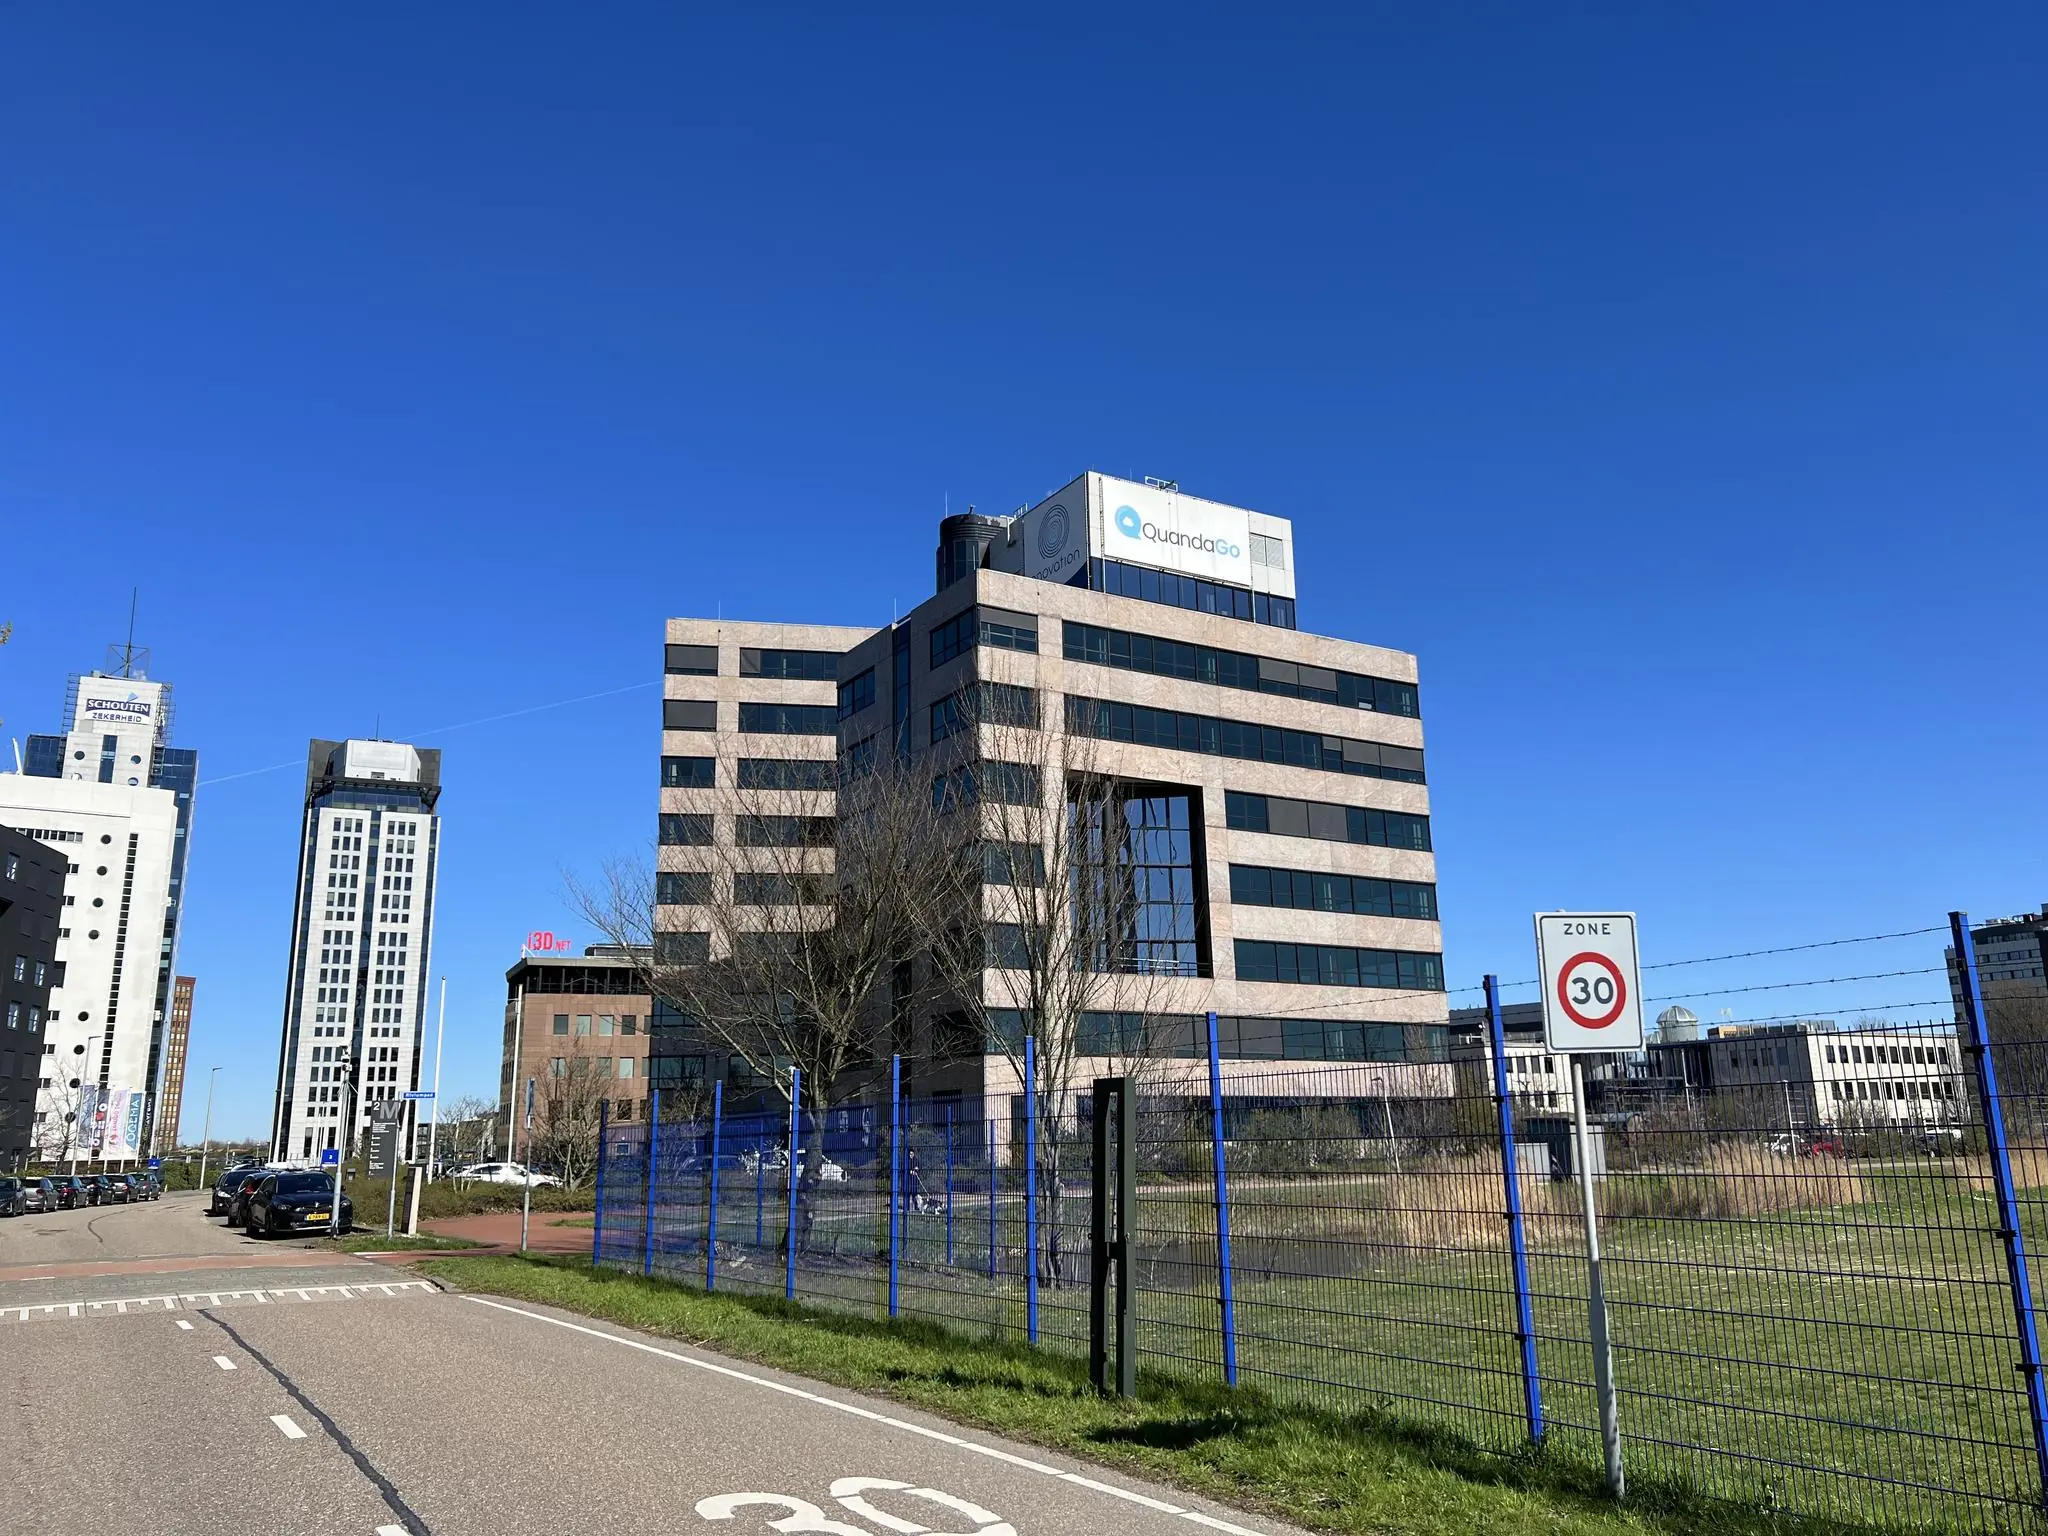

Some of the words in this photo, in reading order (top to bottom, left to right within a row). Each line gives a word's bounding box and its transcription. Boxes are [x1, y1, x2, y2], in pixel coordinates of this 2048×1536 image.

[1142, 522, 1240, 558] QuandaGo
[1032, 549, 1080, 580] novation
[88, 700, 148, 712] SCHOUTEN
[92, 712, 142, 723] ZEKERHEID
[1563, 923, 1611, 935] ZONE
[1571, 977, 1614, 1005] 30
[126, 1099, 140, 1142] OQEMA
